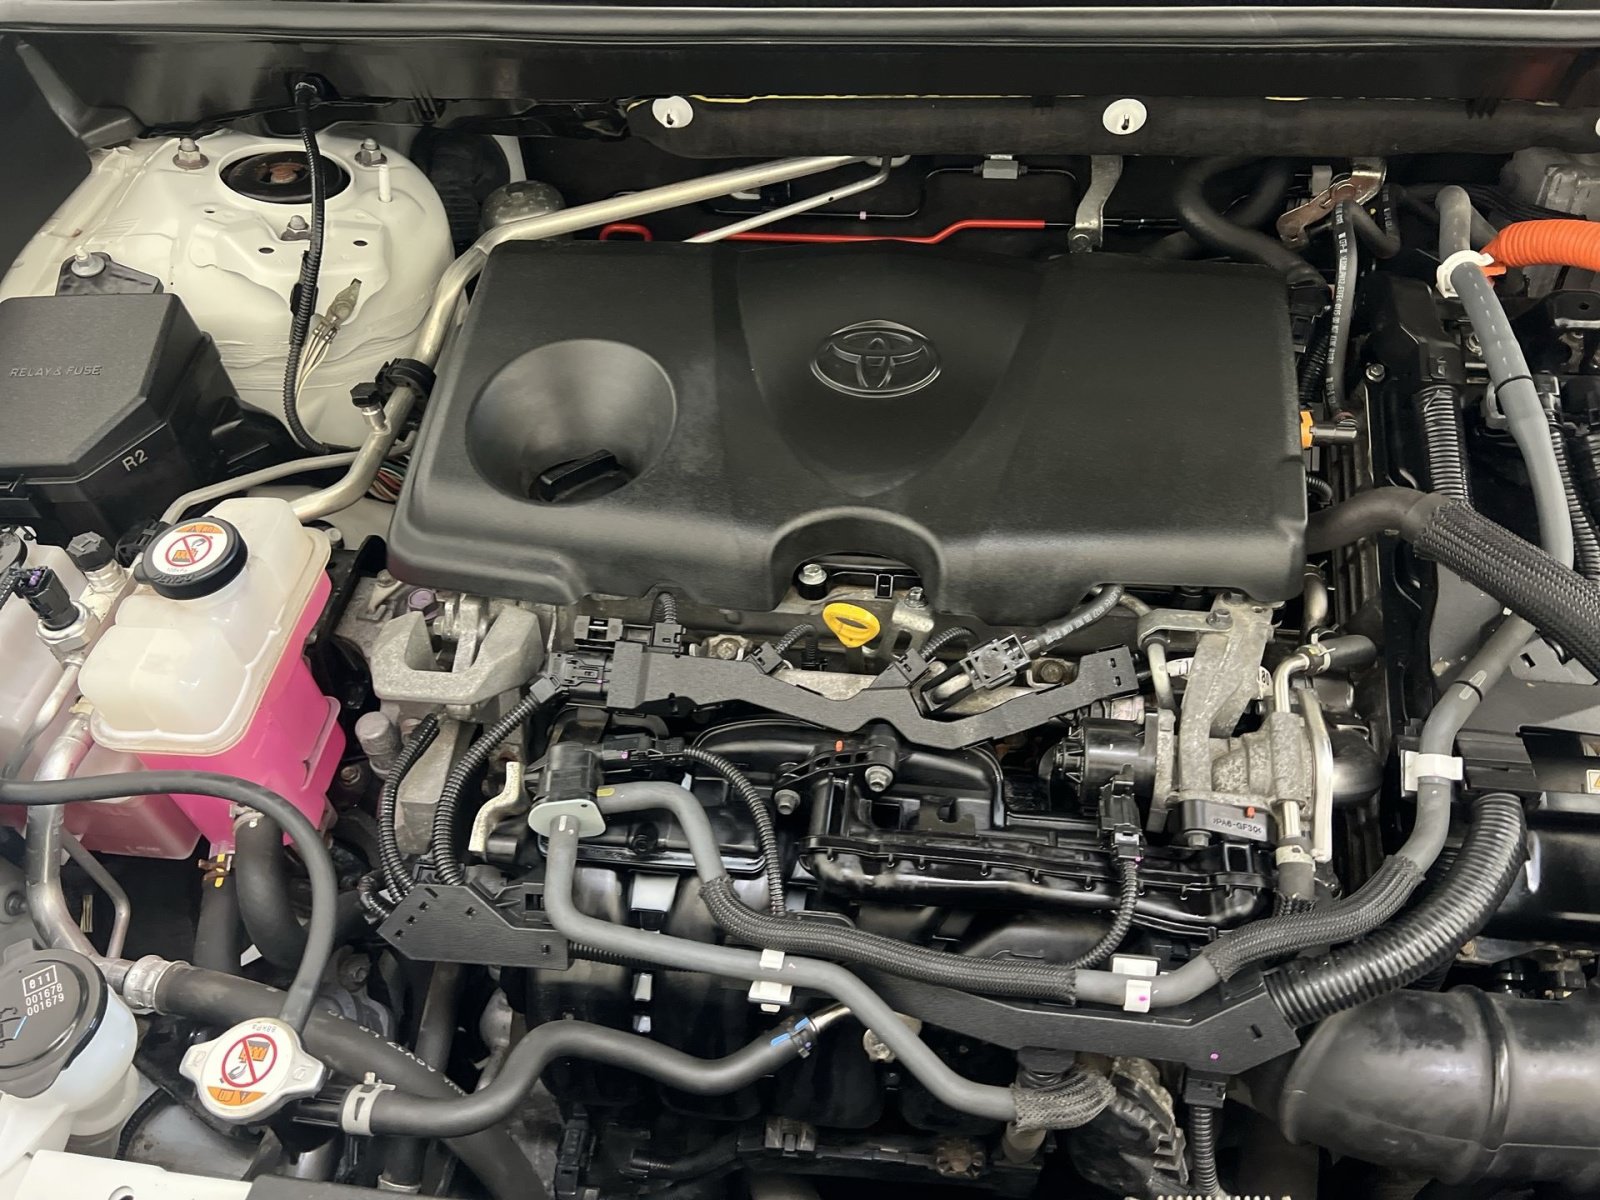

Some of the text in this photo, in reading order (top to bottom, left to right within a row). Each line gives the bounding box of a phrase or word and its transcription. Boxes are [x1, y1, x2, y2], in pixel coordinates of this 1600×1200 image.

[66, 365, 103, 376] FUSE
[122, 449, 149, 471] R2
[25, 982, 63, 1006] 001678
[27, 992, 65, 1016] 001679
